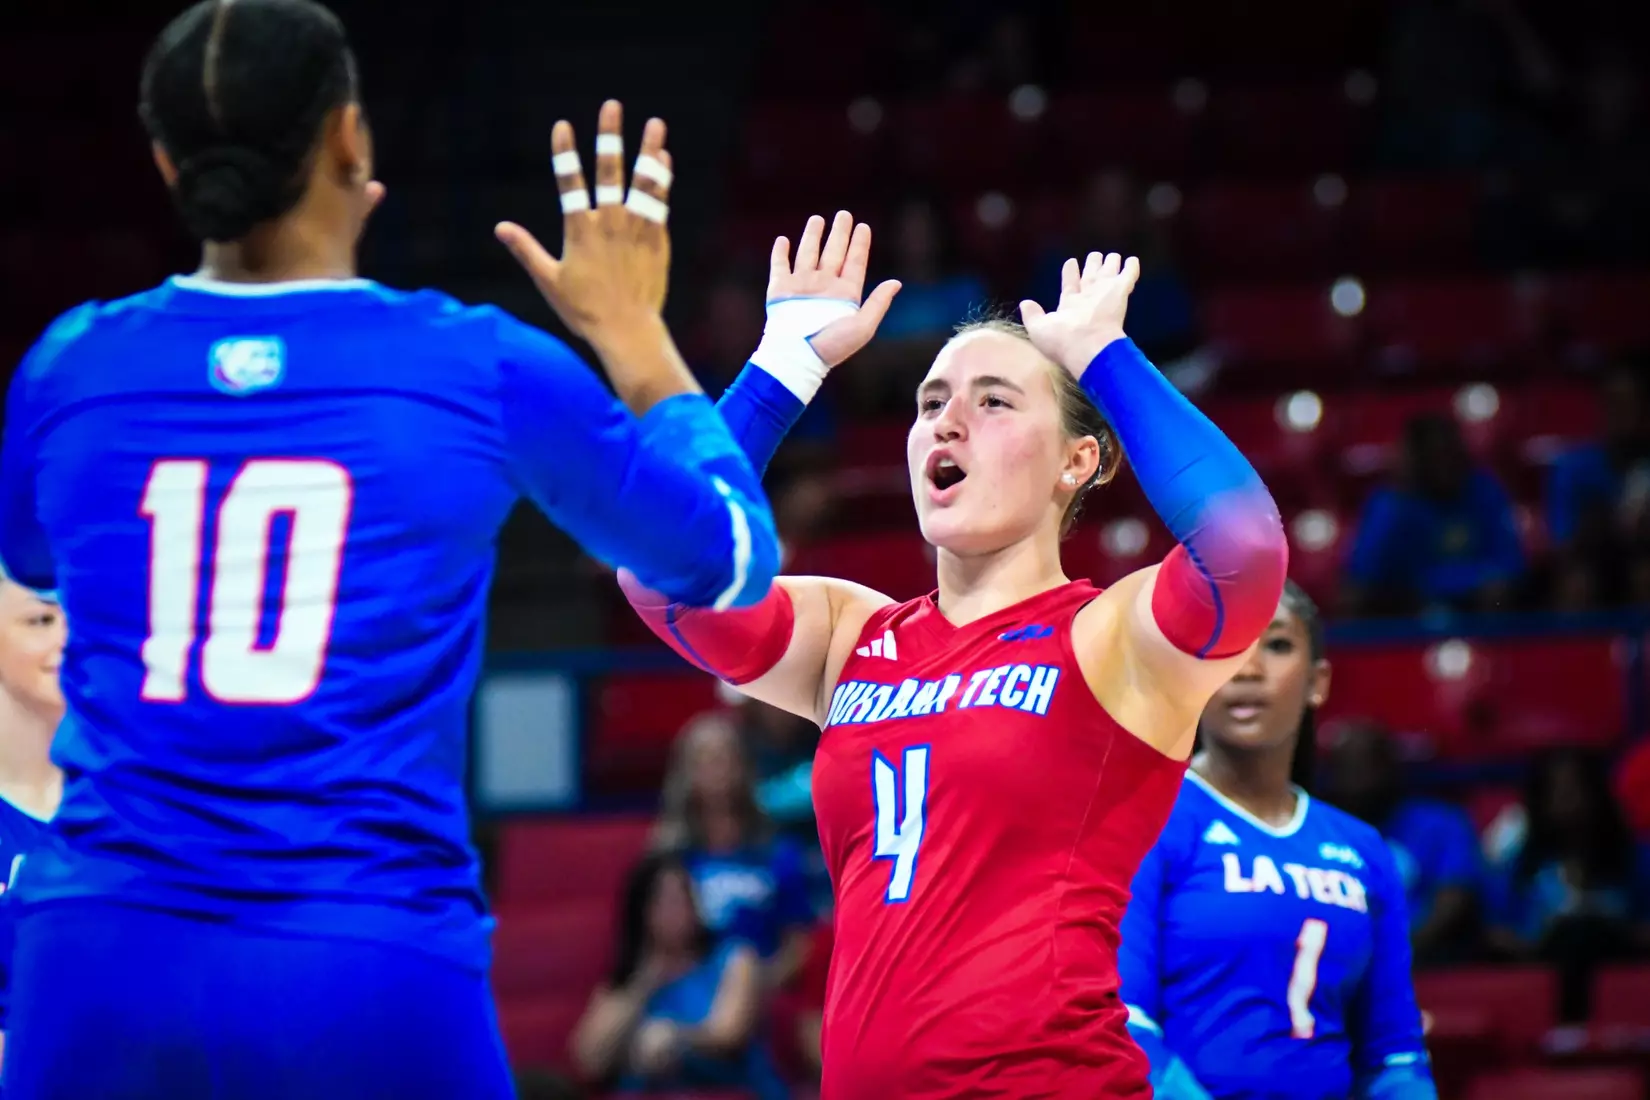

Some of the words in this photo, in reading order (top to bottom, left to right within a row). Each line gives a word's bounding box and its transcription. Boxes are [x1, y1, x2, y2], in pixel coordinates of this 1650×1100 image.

[138, 456, 354, 706] 10
[957, 663, 1060, 716] TECH
[871, 743, 931, 904] 4
[1222, 853, 1285, 894] LA
[1283, 863, 1368, 913] TECH
[1287, 917, 1328, 1039] 1
